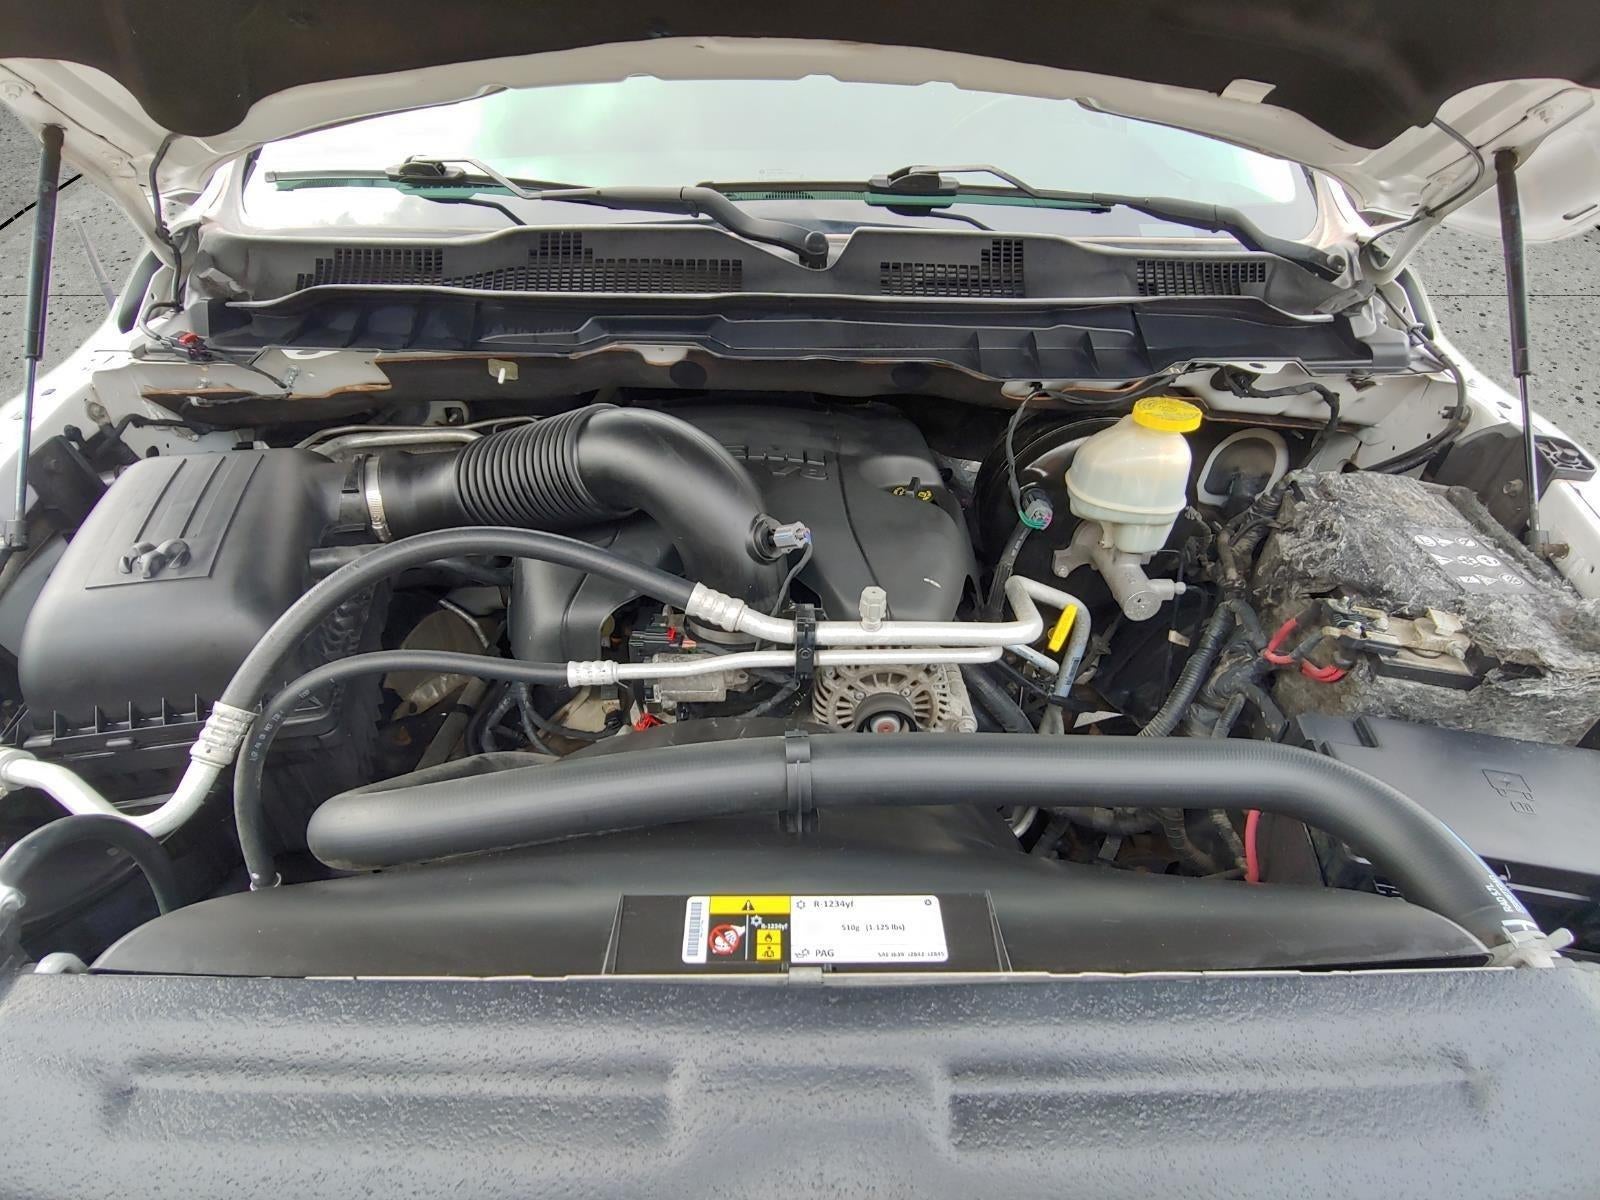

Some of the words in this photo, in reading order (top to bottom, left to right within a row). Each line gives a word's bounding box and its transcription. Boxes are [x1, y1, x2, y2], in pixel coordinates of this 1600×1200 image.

[813, 900, 854, 909] R-1234yf
[841, 924, 860, 933] 510g
[865, 923, 889, 933] (1.125
[891, 923, 906, 933] lbs)
[815, 949, 835, 958] PAG
